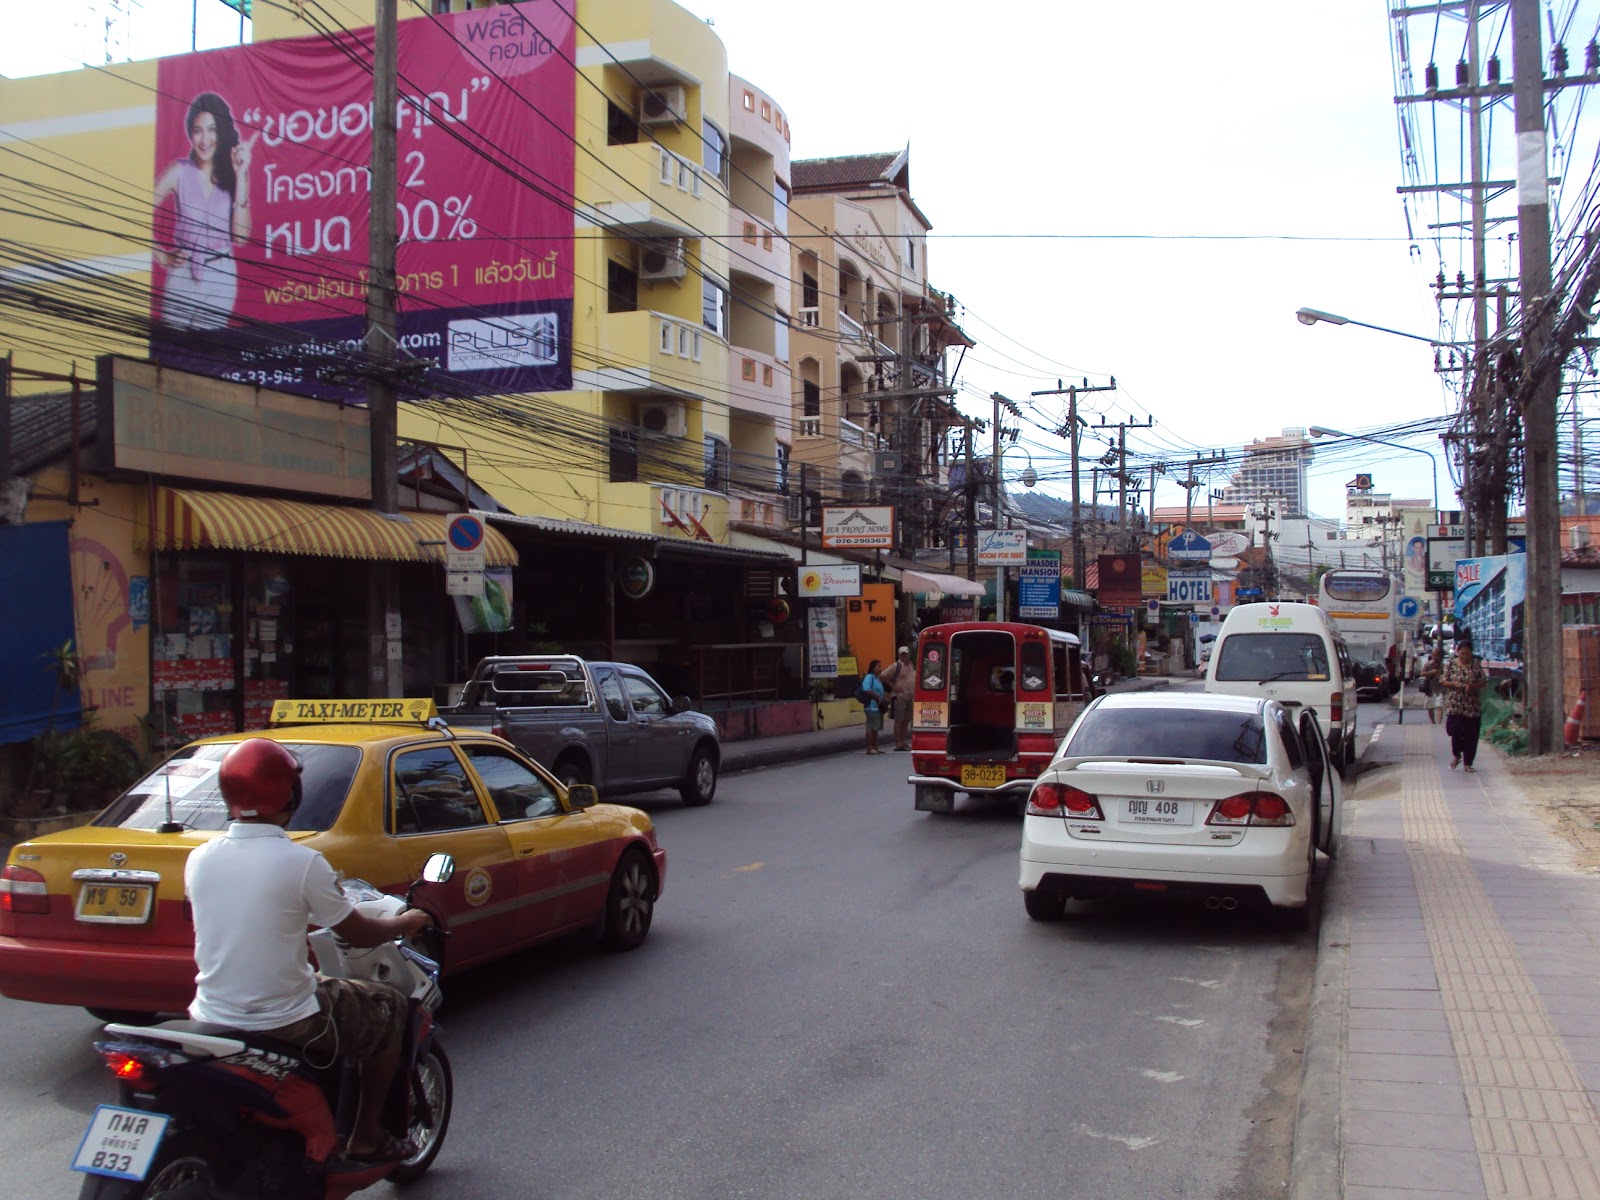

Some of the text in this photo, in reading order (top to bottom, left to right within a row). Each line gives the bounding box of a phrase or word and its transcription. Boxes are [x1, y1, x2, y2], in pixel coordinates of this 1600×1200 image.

[243, 76, 491, 147] “ขอขอคุณ”
[263, 150, 425, 203] โครงกา 2
[265, 215, 352, 259] หมด
[452, 327, 529, 351] PLUS
[868, 525, 889, 533] HOME
[1021, 568, 1059, 576] MANSION
[1025, 560, 1058, 568] AWASDEE
[823, 576, 857, 585] Dreams
[1457, 564, 1481, 589] SALE
[1169, 581, 1210, 600] HOTEL
[943, 607, 973, 616] ROOM
[296, 702, 404, 718] TAXI-METER
[1155, 802, 1179, 815] 408
[119, 889, 138, 906] 59
[92, 1151, 131, 1172] 833
